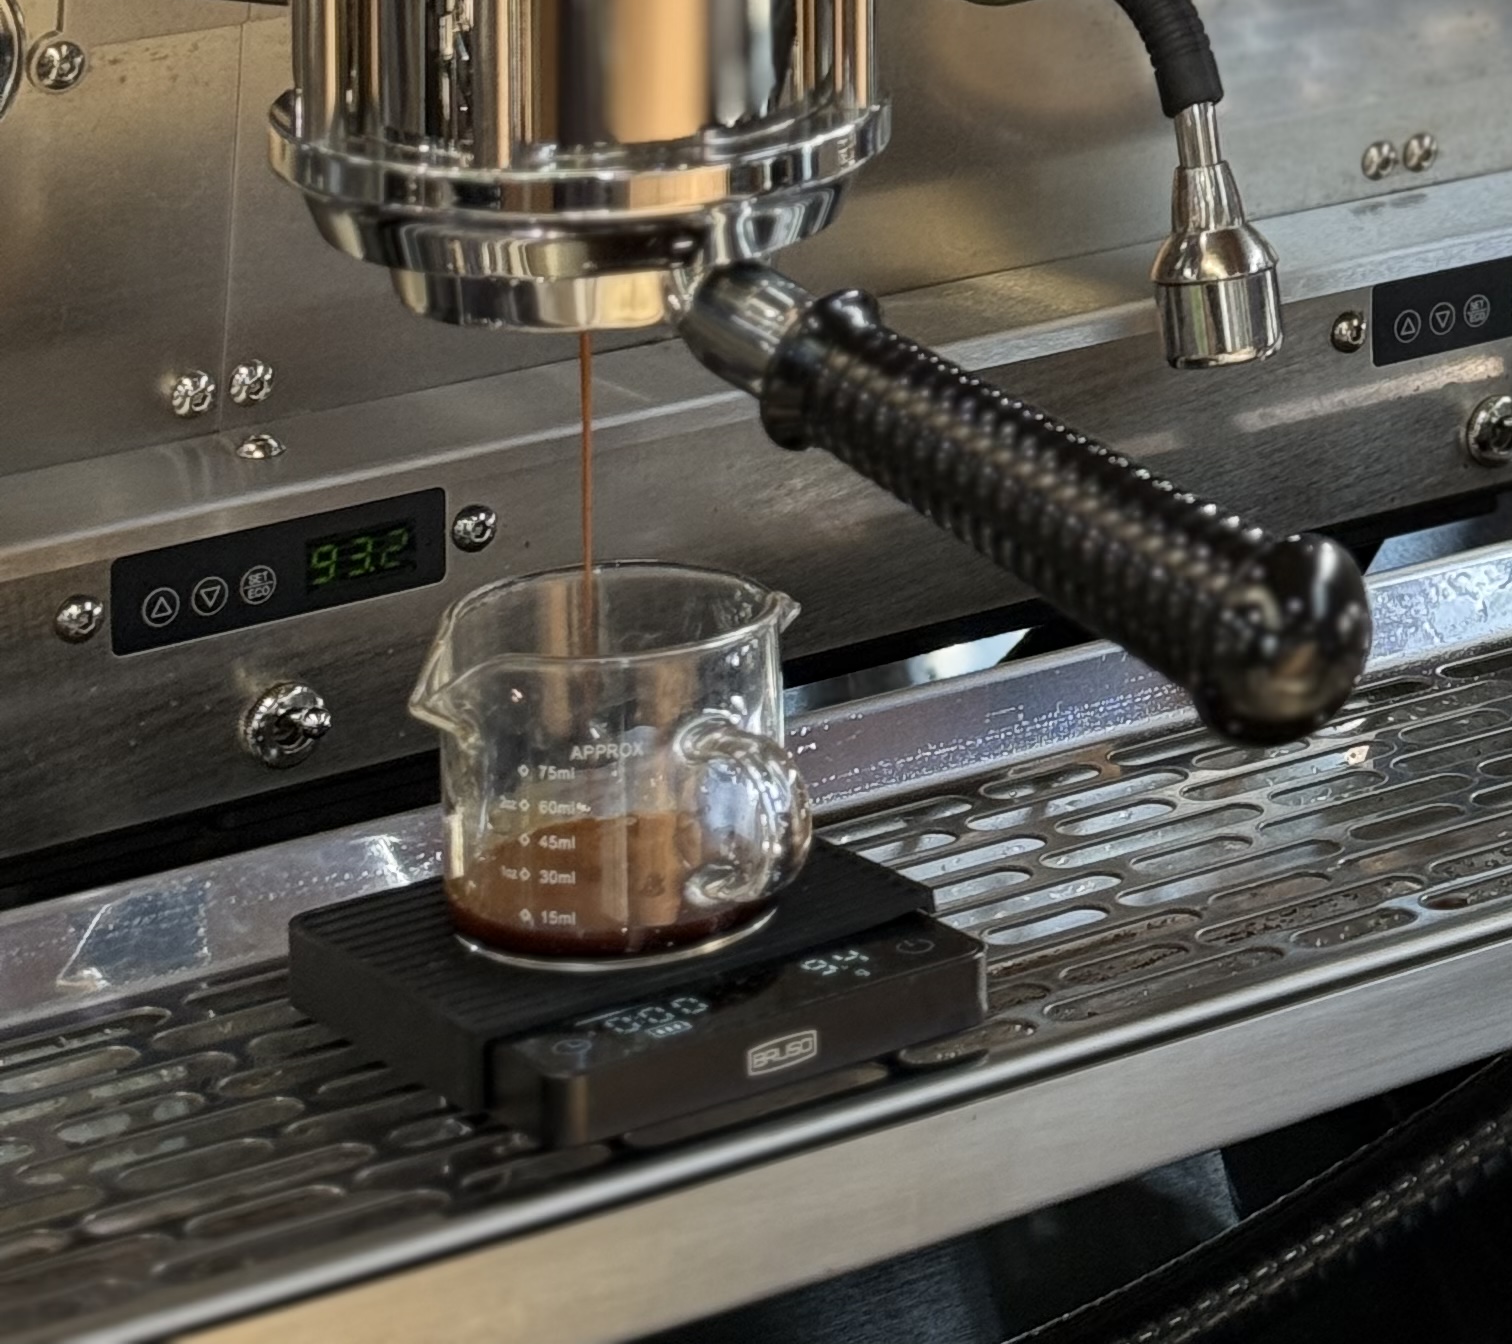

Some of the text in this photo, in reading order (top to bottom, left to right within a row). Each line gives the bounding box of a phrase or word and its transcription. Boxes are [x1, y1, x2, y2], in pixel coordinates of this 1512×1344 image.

[248, 571, 269, 586] SET
[247, 585, 270, 600] ECO
[569, 742, 644, 761] APPROX
[538, 765, 576, 780] 75ml
[538, 800, 576, 814] 60ml
[538, 835, 576, 850] 45ml
[539, 870, 576, 885] 30ml
[541, 910, 576, 925] 15ml
[752, 1037, 813, 1069] BRUSO
